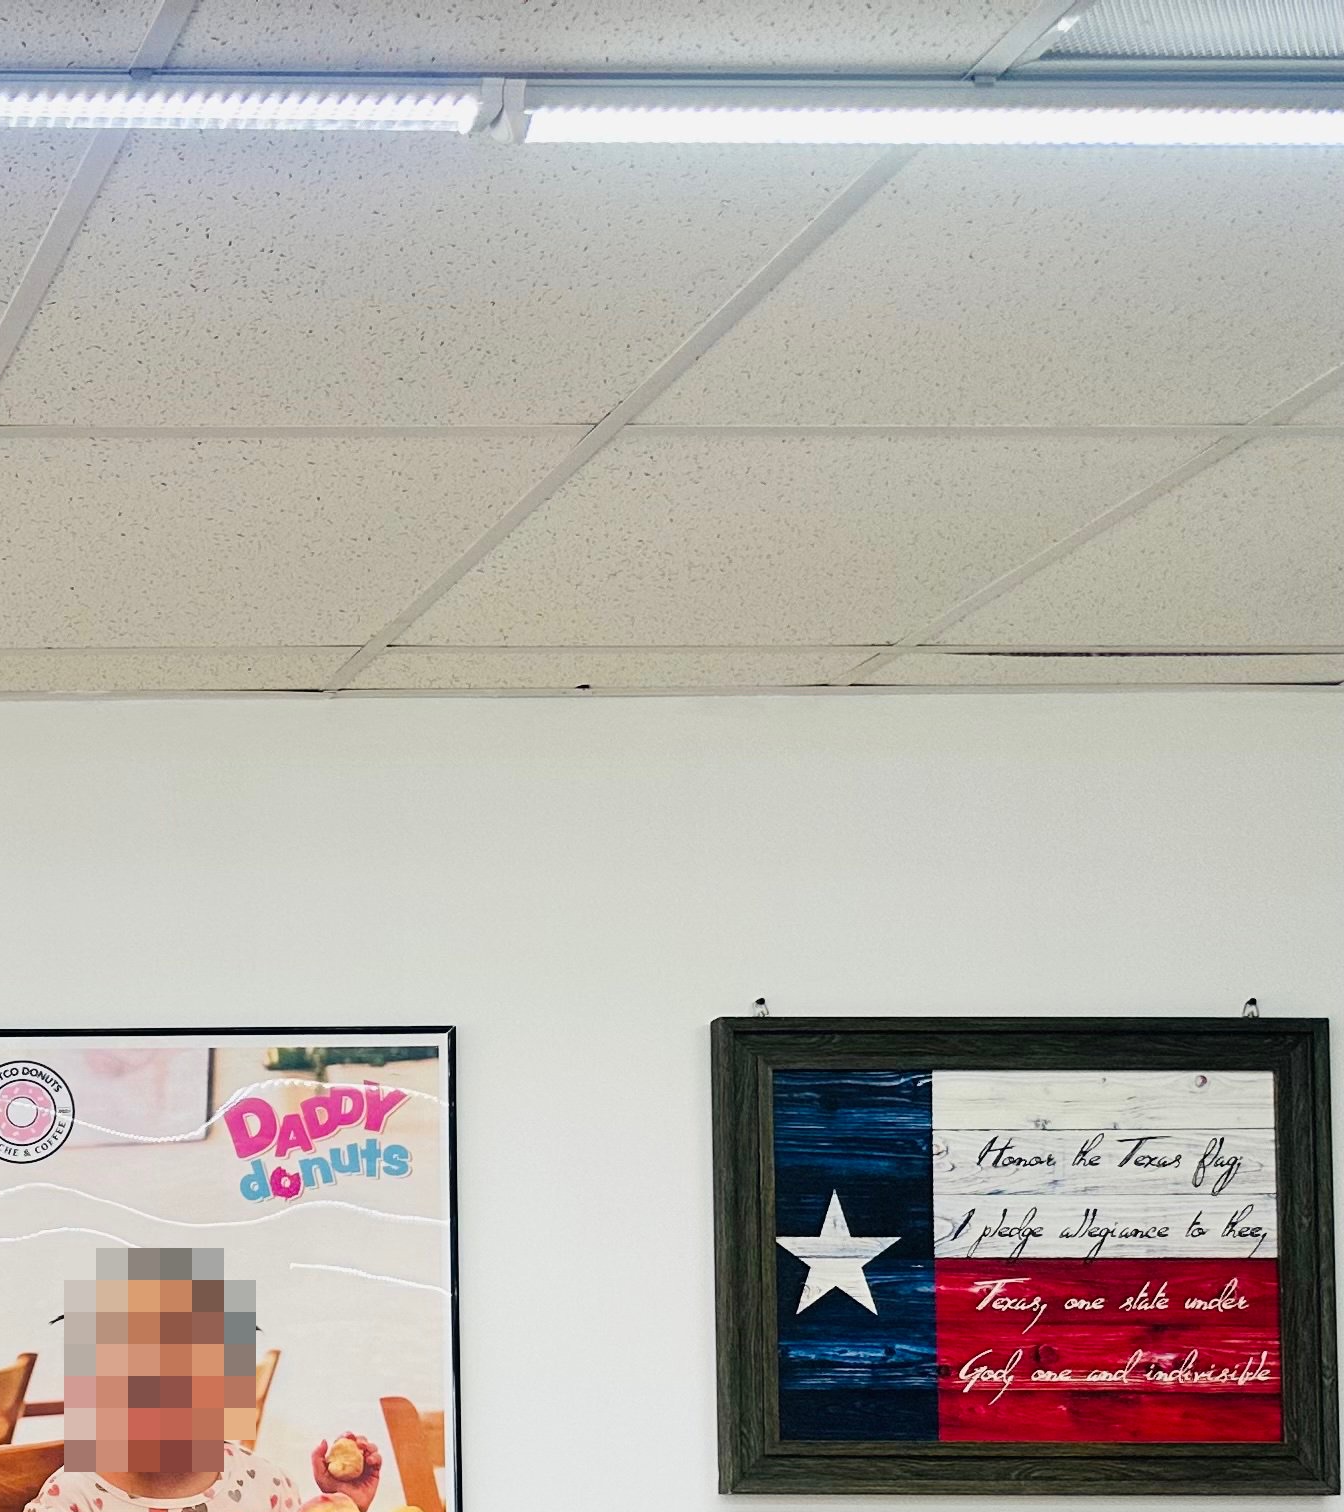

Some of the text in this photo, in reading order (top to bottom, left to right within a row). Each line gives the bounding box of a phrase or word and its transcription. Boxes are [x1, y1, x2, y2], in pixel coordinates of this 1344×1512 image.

[22, 1067, 62, 1092] DONUTS
[34, 1121, 66, 1154] COFFEE
[224, 1080, 408, 1158] DADDY
[240, 1139, 409, 1200] donuts
[977, 1135, 1056, 1168] Honor
[1071, 1132, 1104, 1167] the
[1116, 1135, 1181, 1168] Texas
[951, 1204, 1267, 1264] I pledge allegiance to thee,
[974, 1277, 1250, 1335] Texas, one state under
[958, 1349, 1272, 1406] God, one and indivisible
